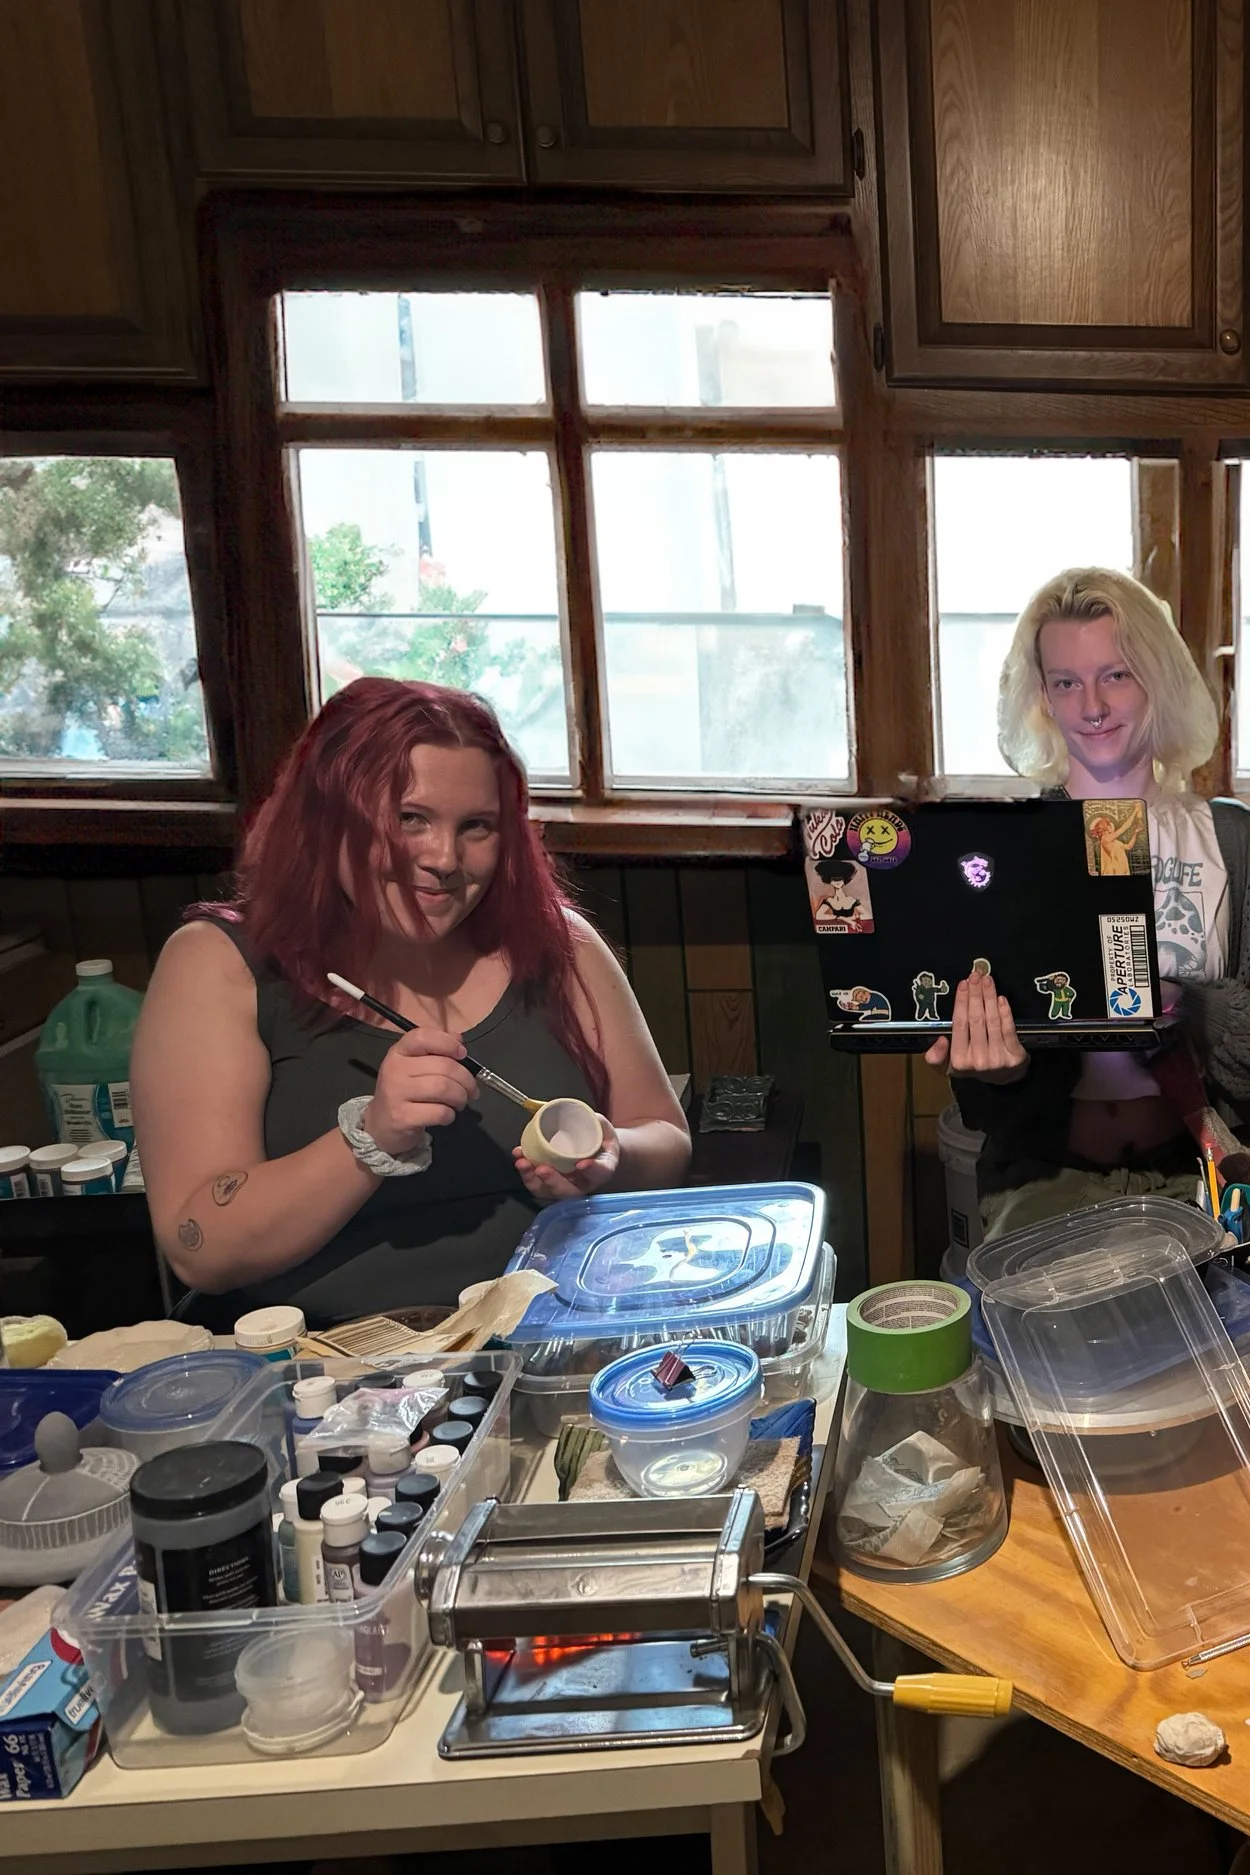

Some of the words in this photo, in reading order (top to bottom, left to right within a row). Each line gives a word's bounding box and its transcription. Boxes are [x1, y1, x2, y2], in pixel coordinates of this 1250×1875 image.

[820, 818, 845, 856] Cola
[1106, 935, 1113, 944] OF
[1122, 926, 1134, 987] LABORATORIES
[1108, 948, 1116, 982] PROPERTY
[1111, 925, 1128, 995] APERTURE
[3, 1734, 20, 1754] 66
[12, 1762, 31, 1798] Paper
